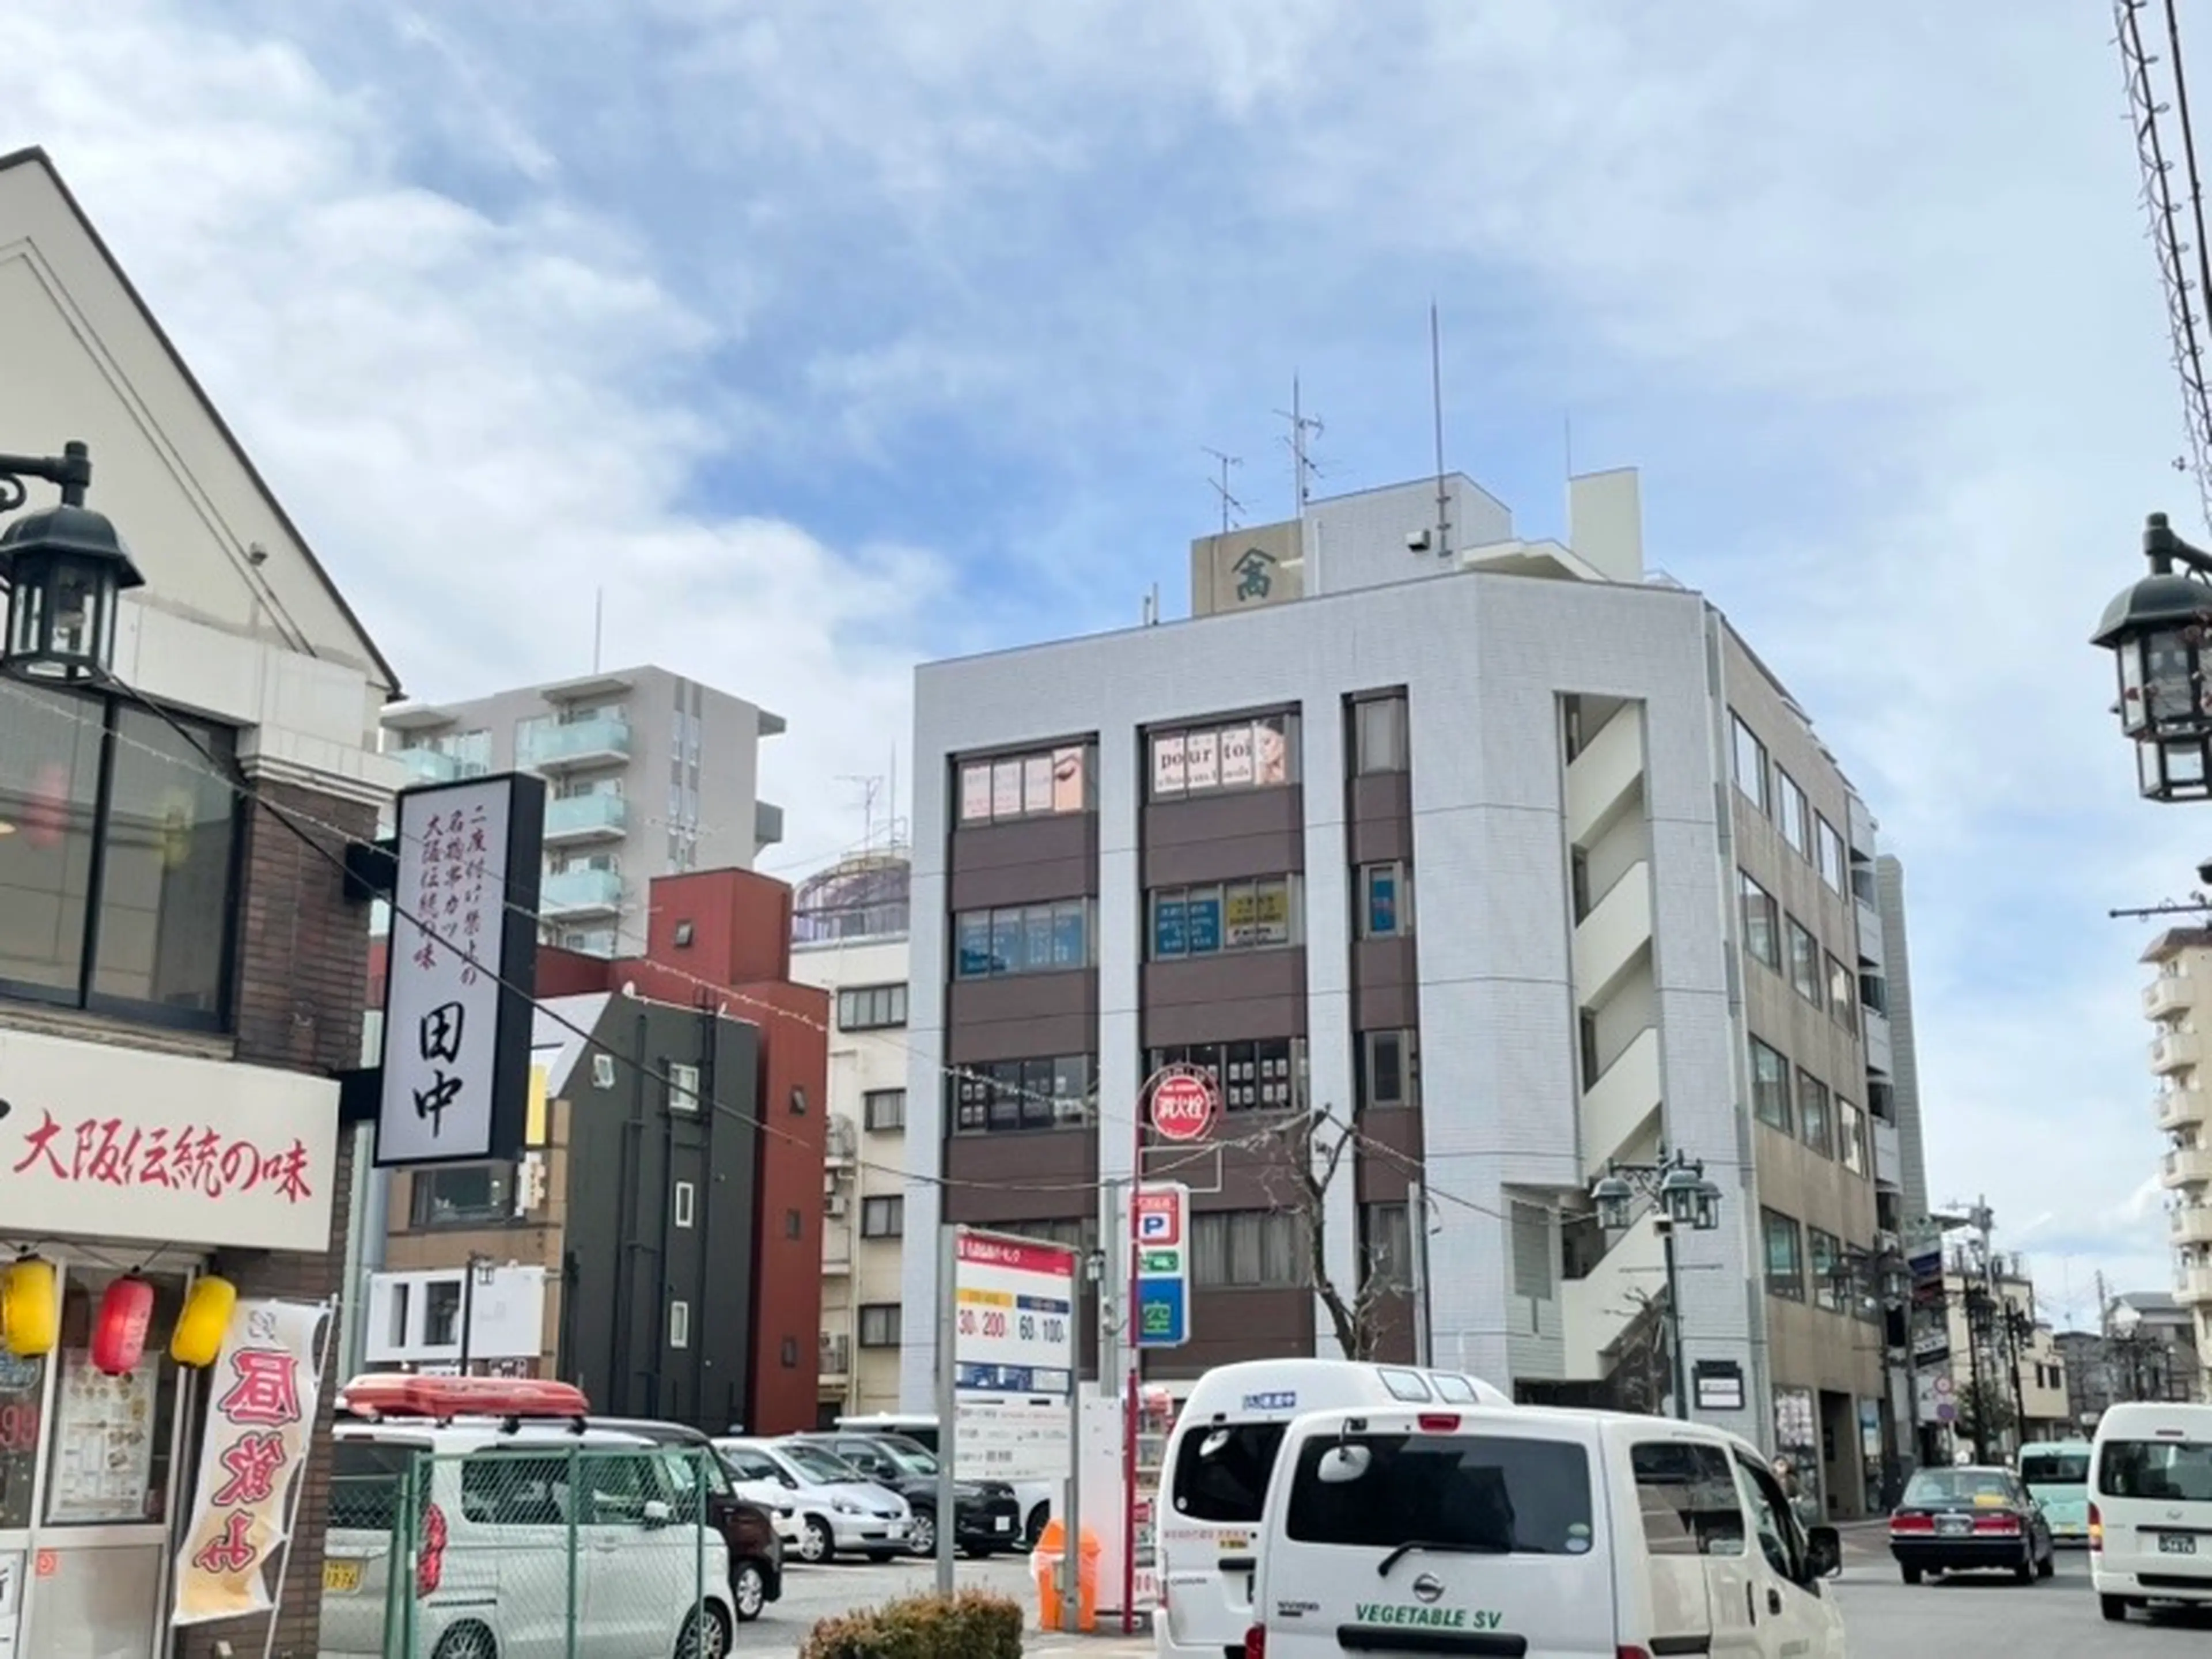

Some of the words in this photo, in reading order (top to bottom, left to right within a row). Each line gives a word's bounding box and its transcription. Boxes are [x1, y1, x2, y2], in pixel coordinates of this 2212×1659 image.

[412, 1001, 465, 1138] 田中
[1158, 1094, 1204, 1120] 消火栓
[13, 1107, 313, 1204] 大阪伝統の味
[1143, 1215, 1164, 1234] P
[1355, 1604, 1467, 1627] VEGETABLE
[1473, 1609, 1503, 1629] SV
